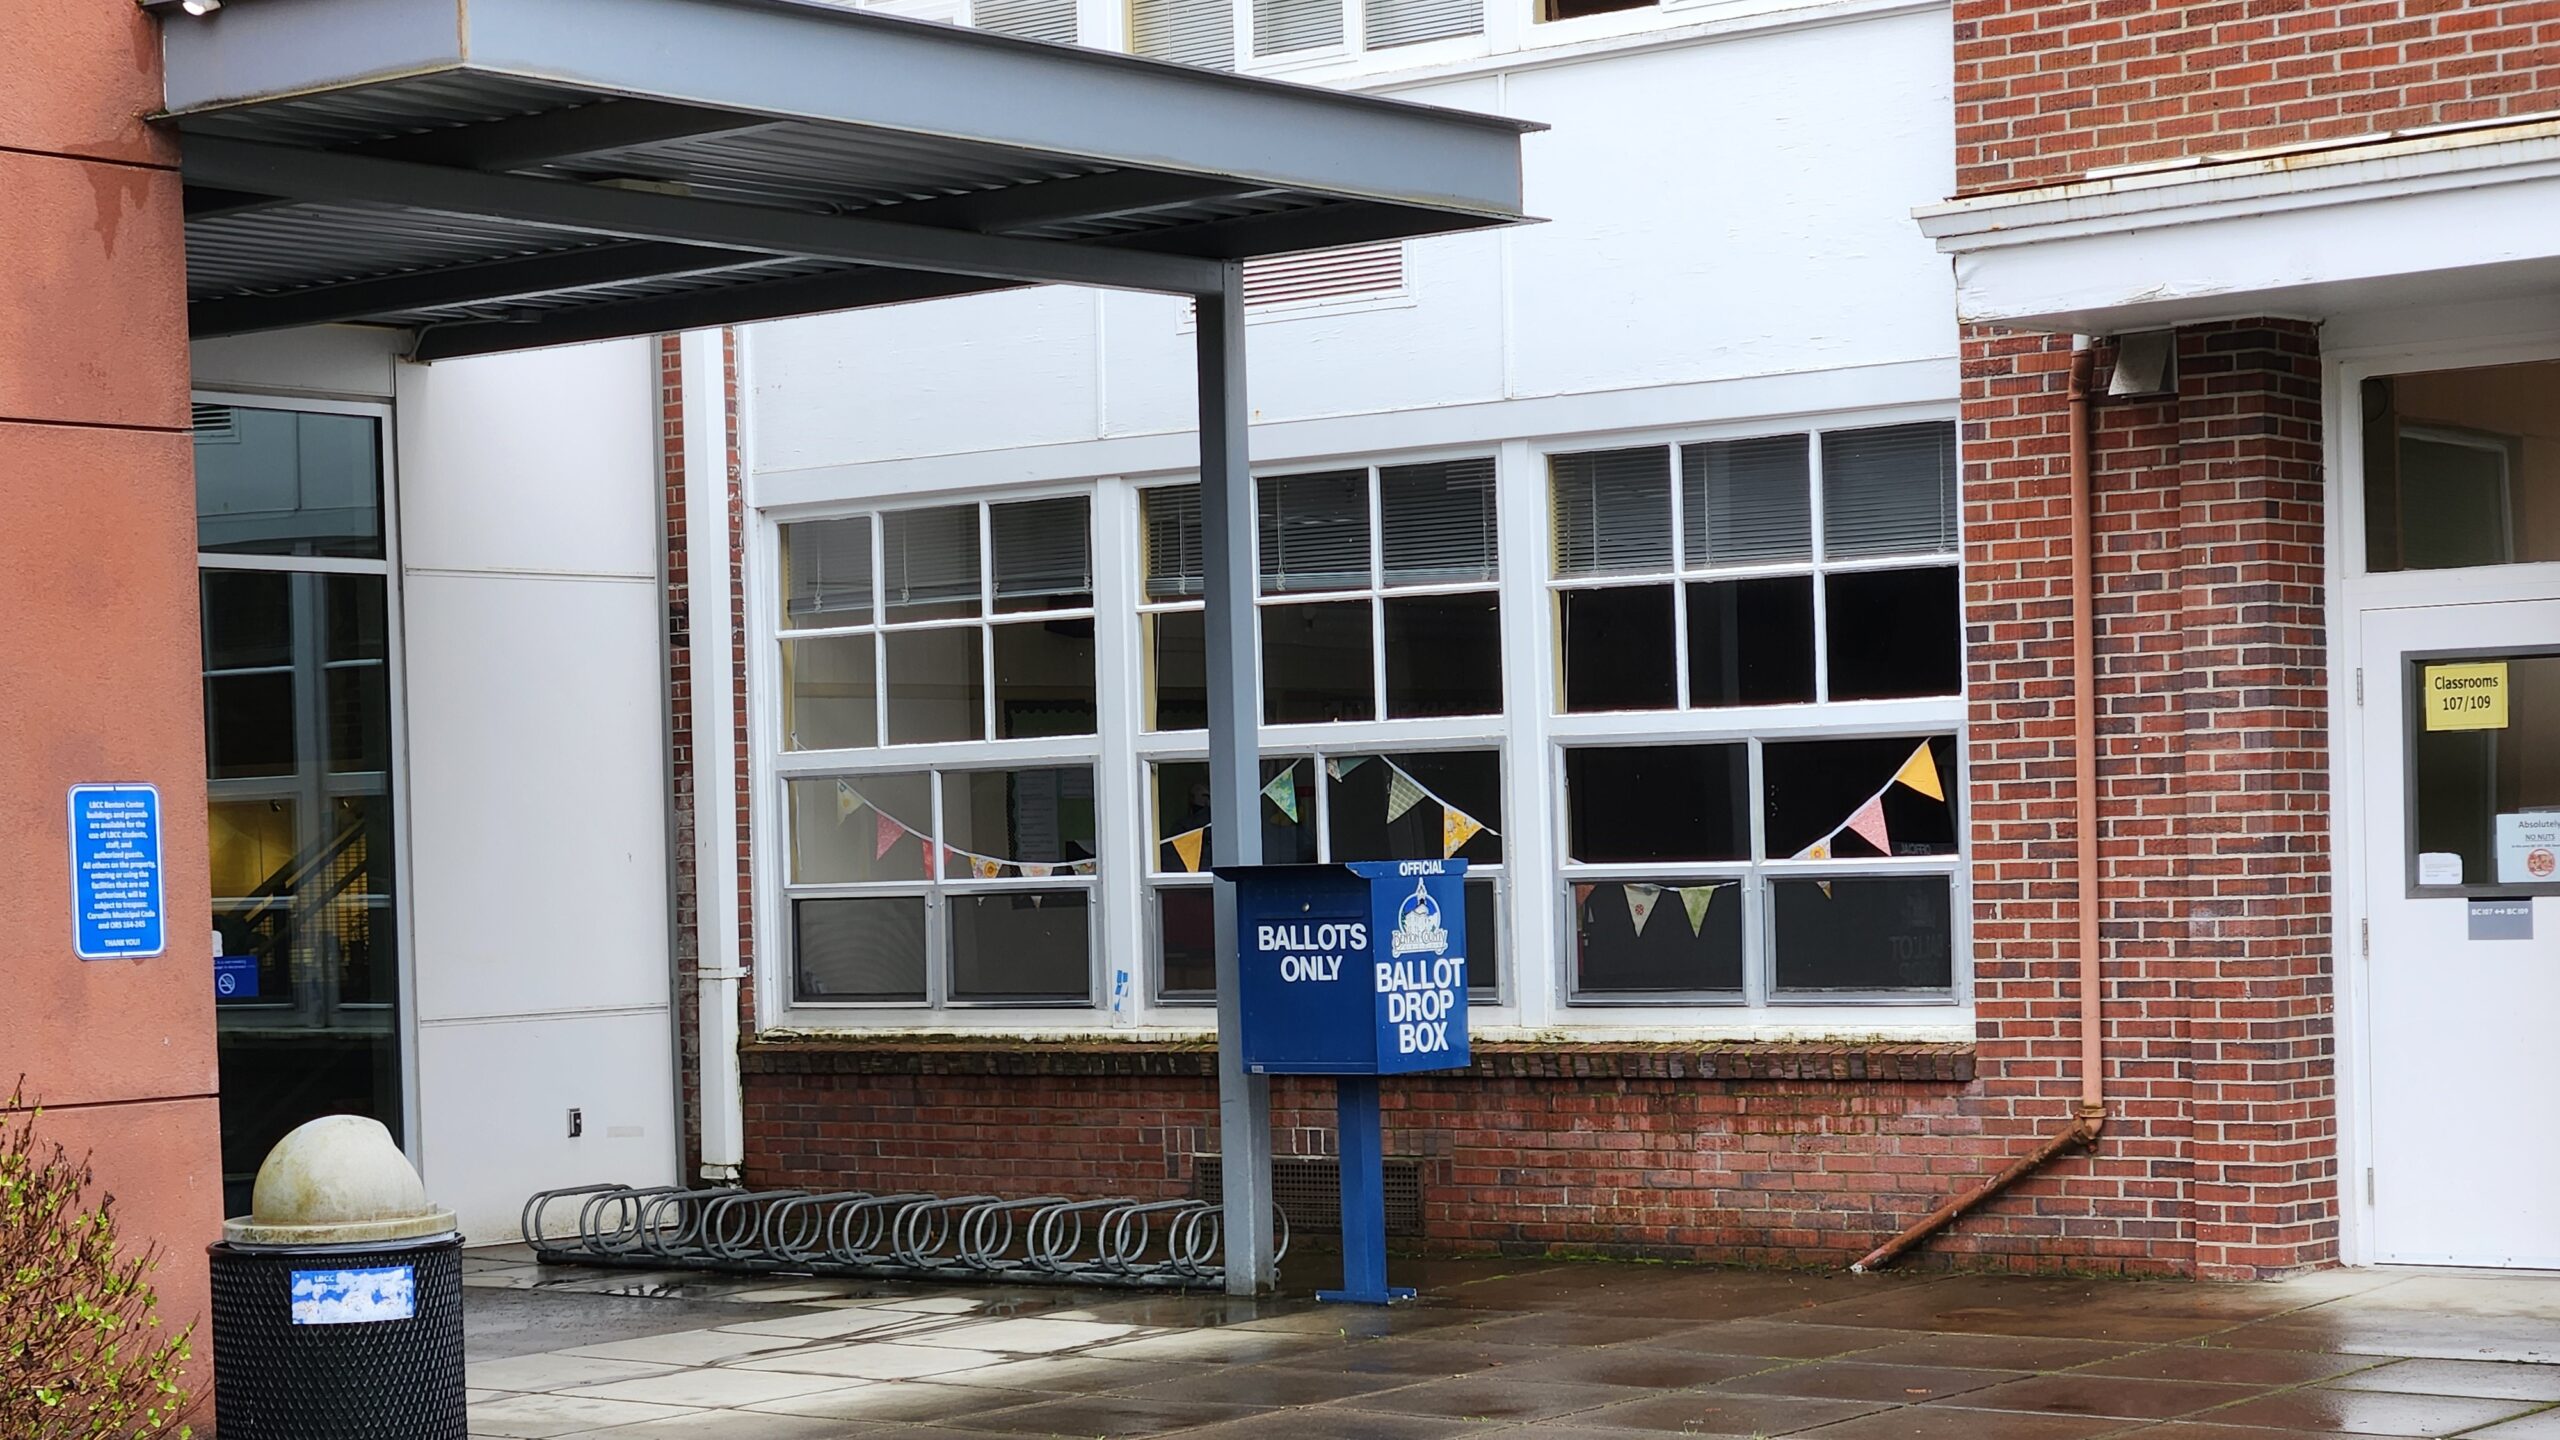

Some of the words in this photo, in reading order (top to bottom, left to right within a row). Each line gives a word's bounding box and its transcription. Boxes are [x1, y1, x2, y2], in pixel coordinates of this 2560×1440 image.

[2434, 675, 2499, 690] Classrooms
[2442, 696, 2491, 712] 107/109
[1400, 860, 1446, 876] OFFICIAL
[94, 902, 115, 910] subject
[1258, 924, 1367, 951] BALLOTS
[1280, 955, 1342, 982] ONLY
[1376, 958, 1465, 992] BALLOT
[1388, 990, 1455, 1024] DROP
[1399, 1022, 1449, 1054] BOX
